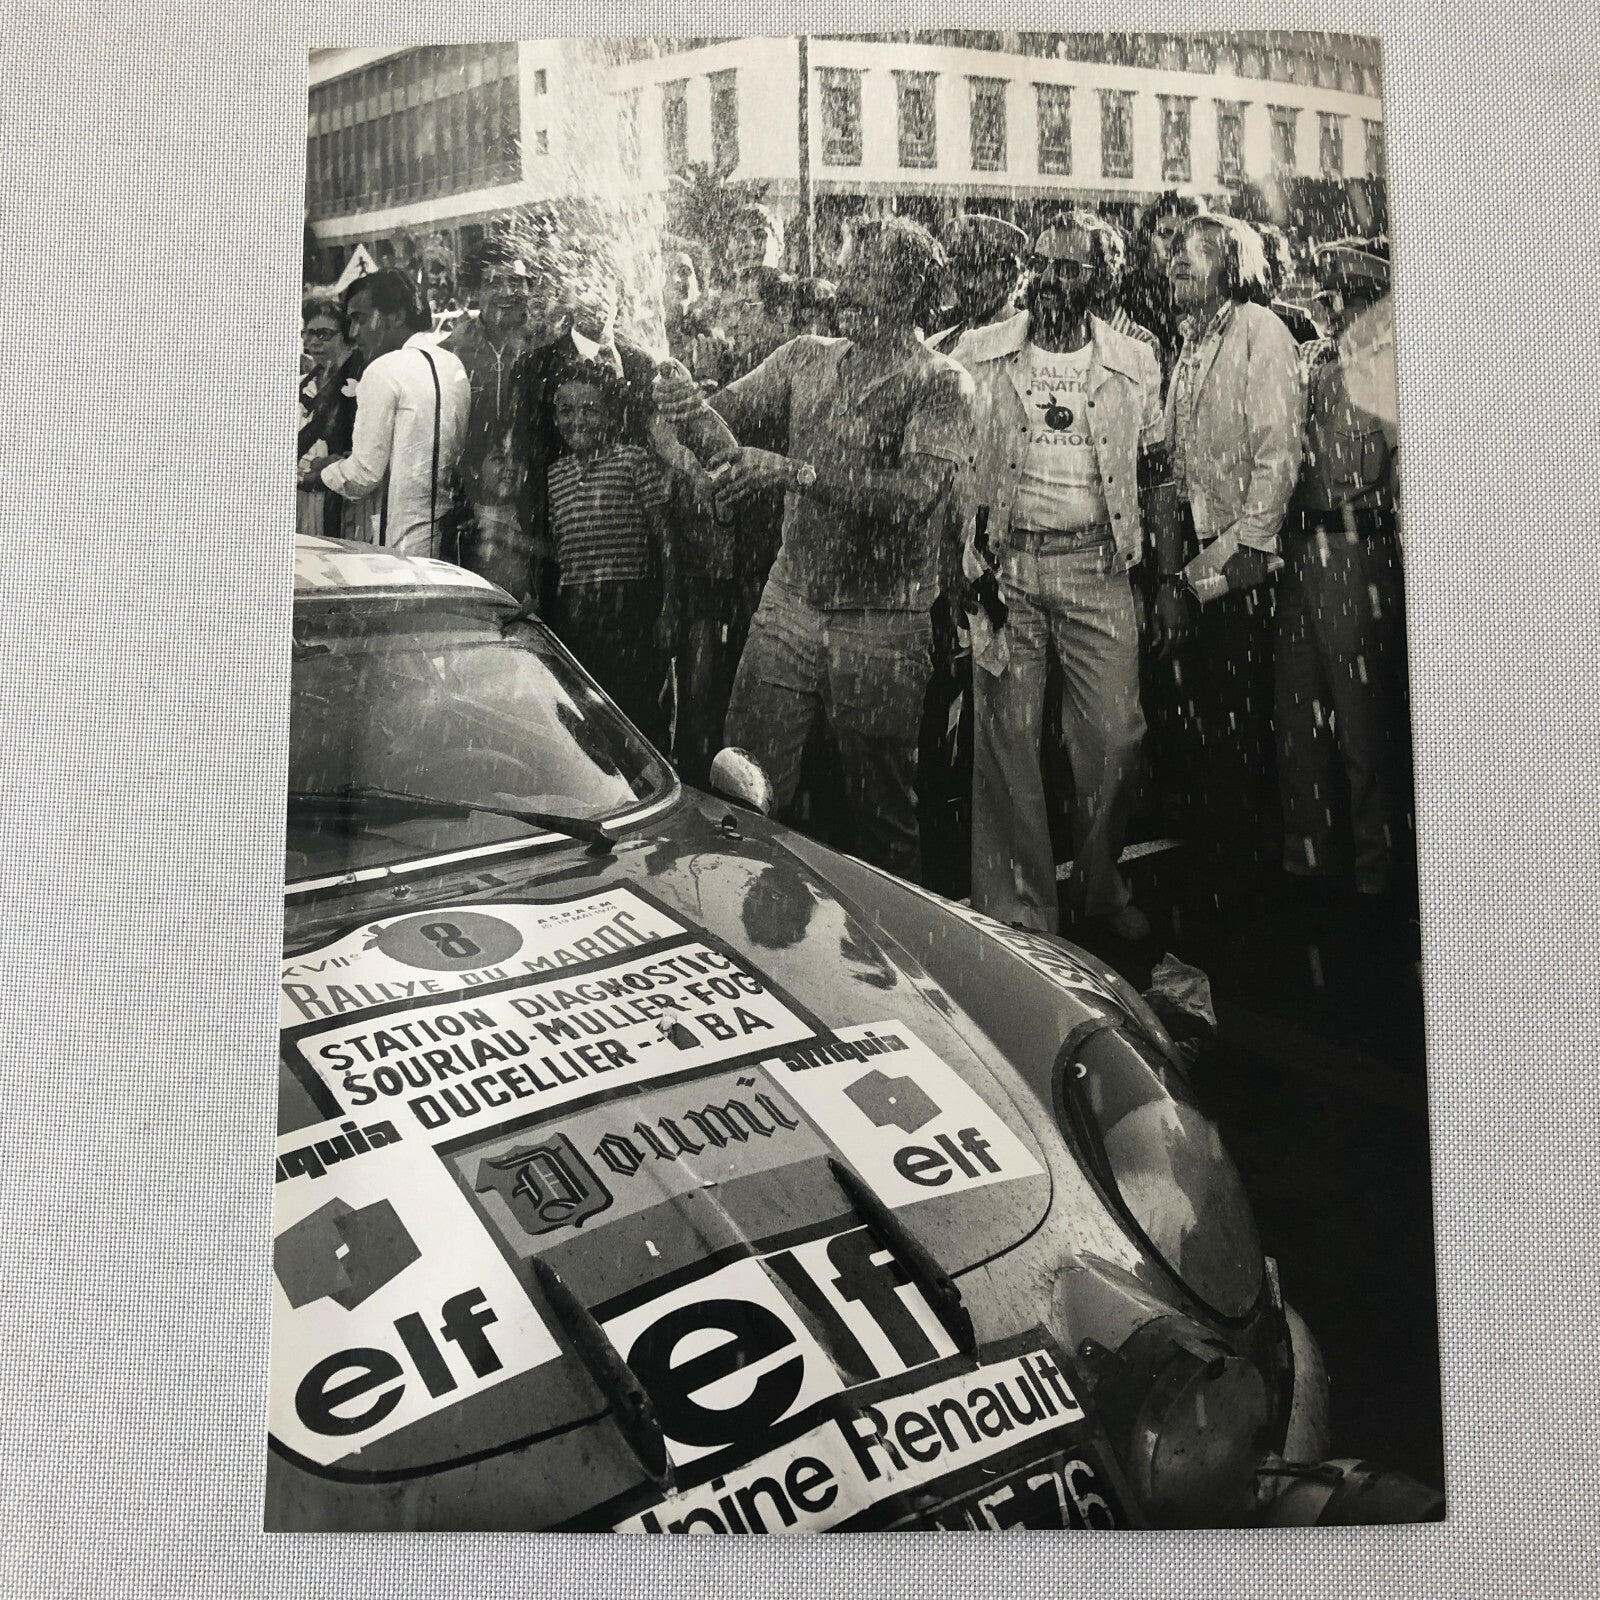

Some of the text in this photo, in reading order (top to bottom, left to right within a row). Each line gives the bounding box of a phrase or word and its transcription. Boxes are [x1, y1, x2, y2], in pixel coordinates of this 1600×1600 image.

[1030, 432, 1096, 447] AROC
[282, 911, 661, 1020] RALLYE DU MAROC
[420, 923, 481, 958] 8
[319, 952, 731, 1071] STATION DIAGNOSTIC
[893, 1127, 1002, 1186] elf
[295, 1286, 503, 1436] elf
[626, 1224, 941, 1447] elf
[834, 1355, 1078, 1482] Renault
